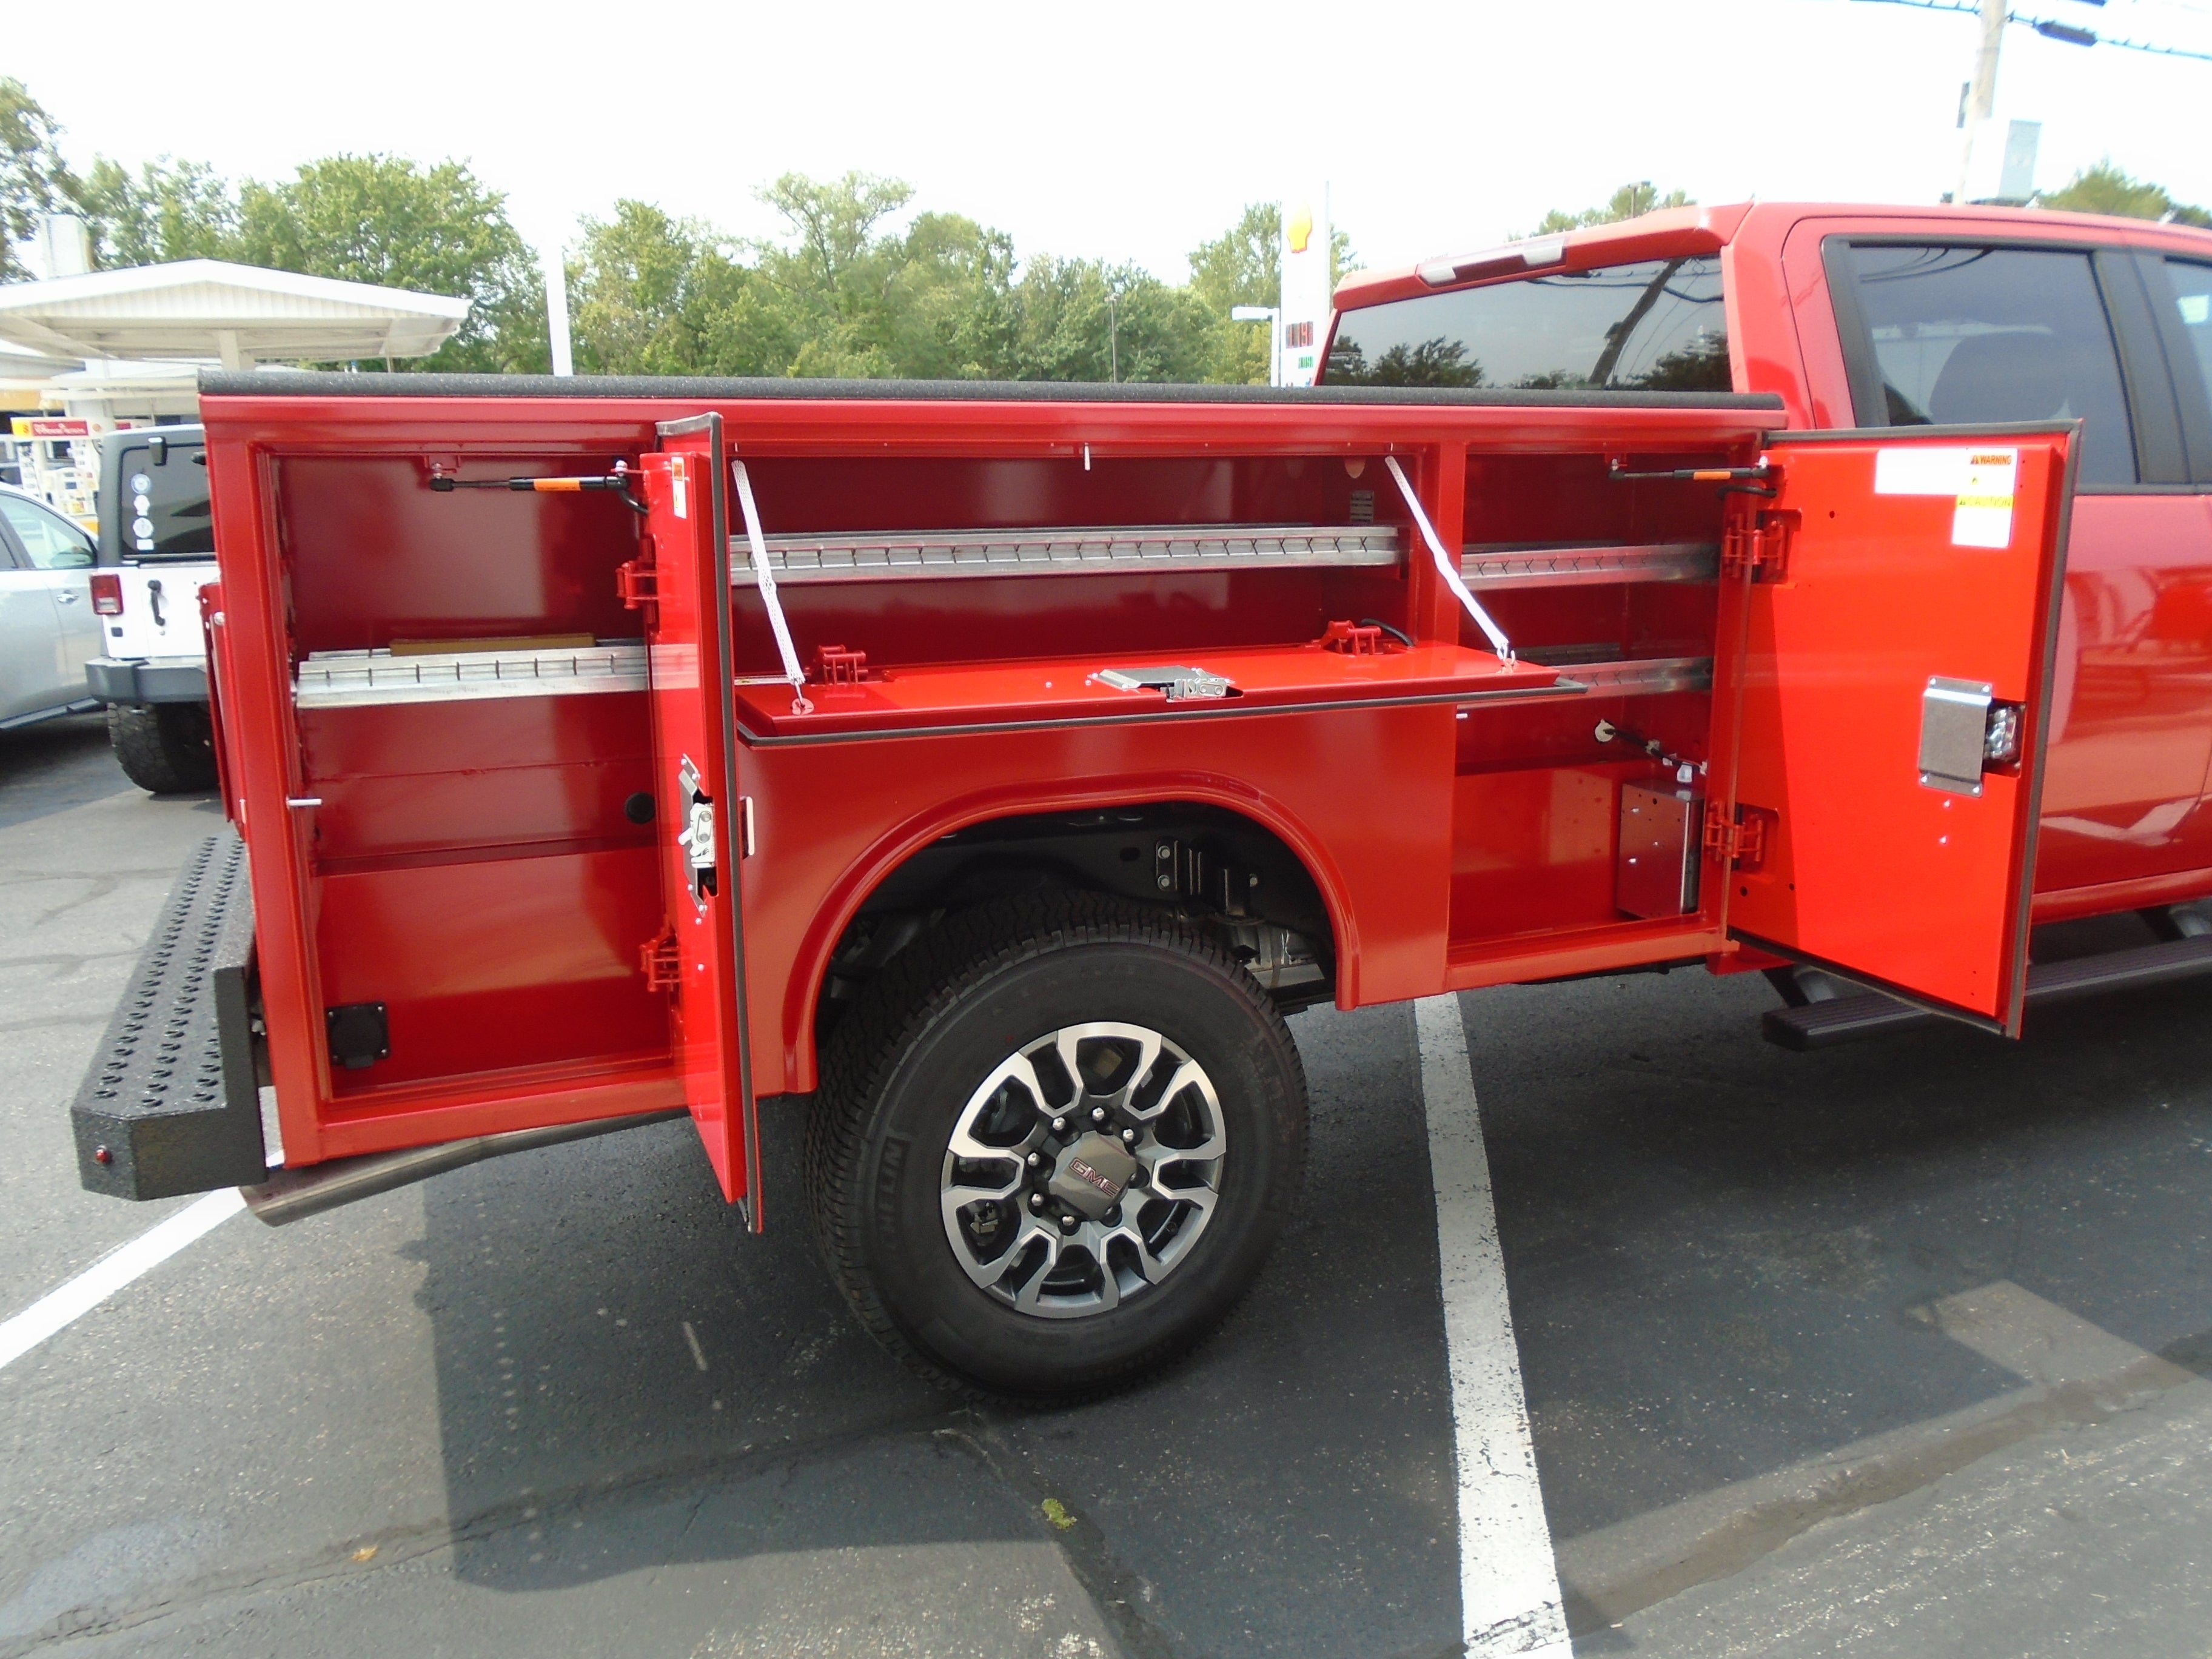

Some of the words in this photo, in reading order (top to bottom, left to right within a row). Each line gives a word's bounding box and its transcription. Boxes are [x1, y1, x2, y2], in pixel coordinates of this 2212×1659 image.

[1980, 455, 2012, 465] WARNING
[1968, 495, 2011, 507] CAUTION
[1069, 1156, 1120, 1198] GMC
